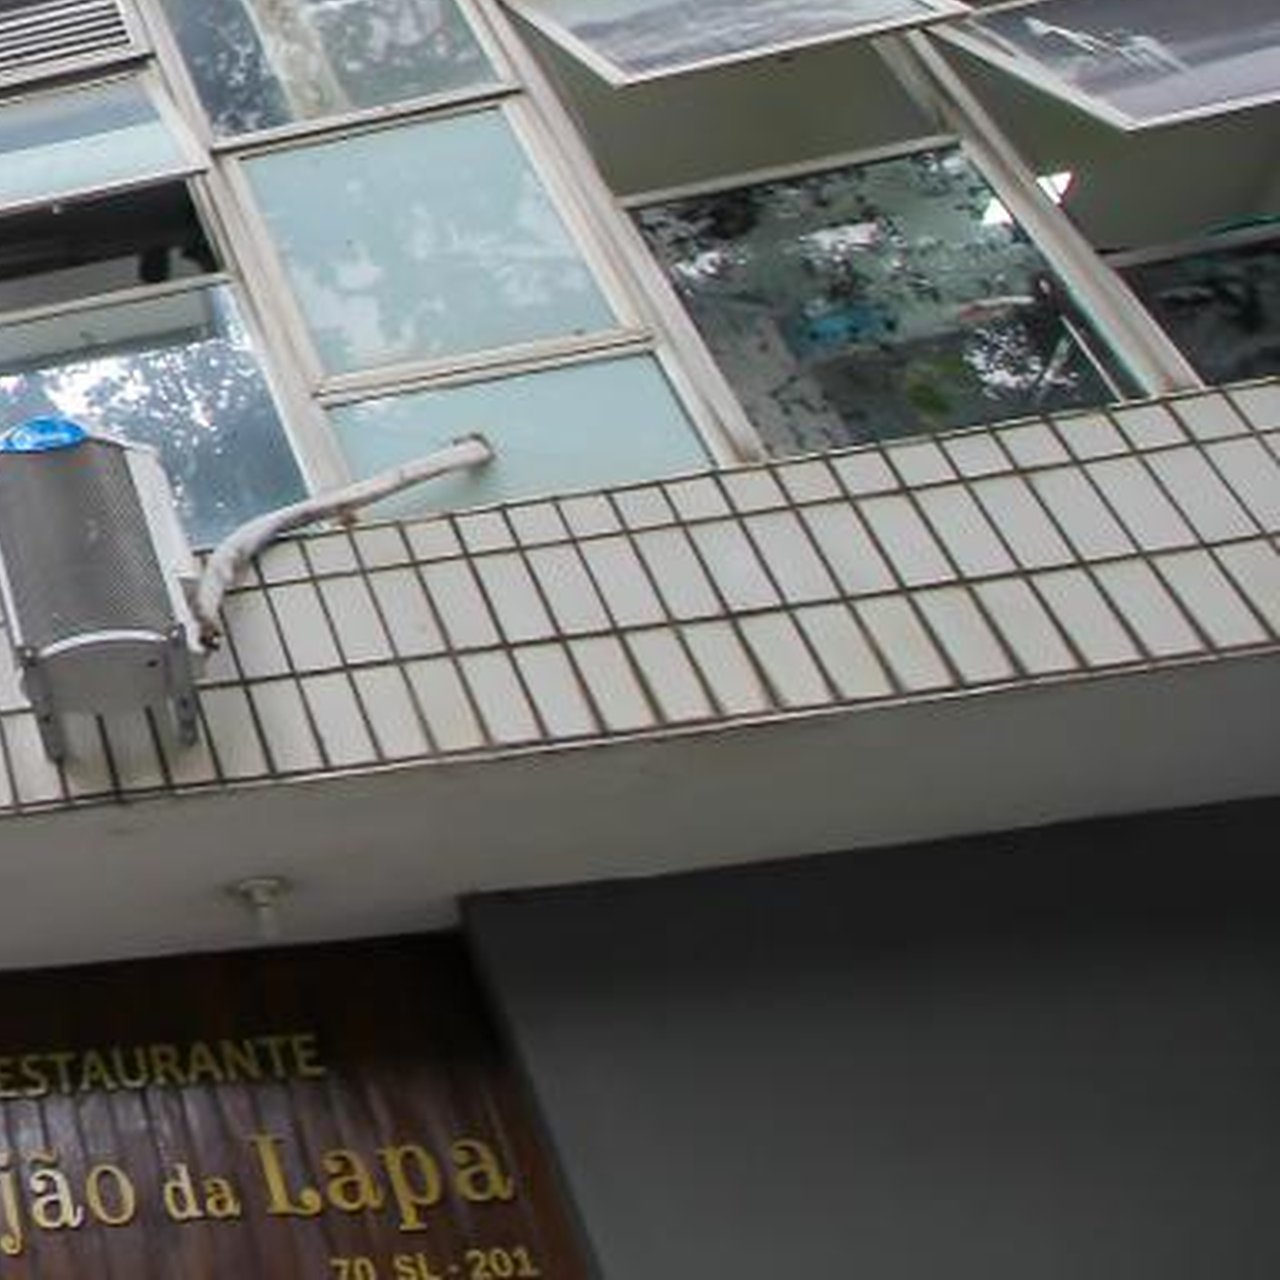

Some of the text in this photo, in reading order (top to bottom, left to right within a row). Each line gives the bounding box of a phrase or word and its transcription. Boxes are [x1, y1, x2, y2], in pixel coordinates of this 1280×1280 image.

[162, 1163, 241, 1221] da
[249, 1132, 516, 1231] Lapa
[329, 1256, 376, 1280] 70
